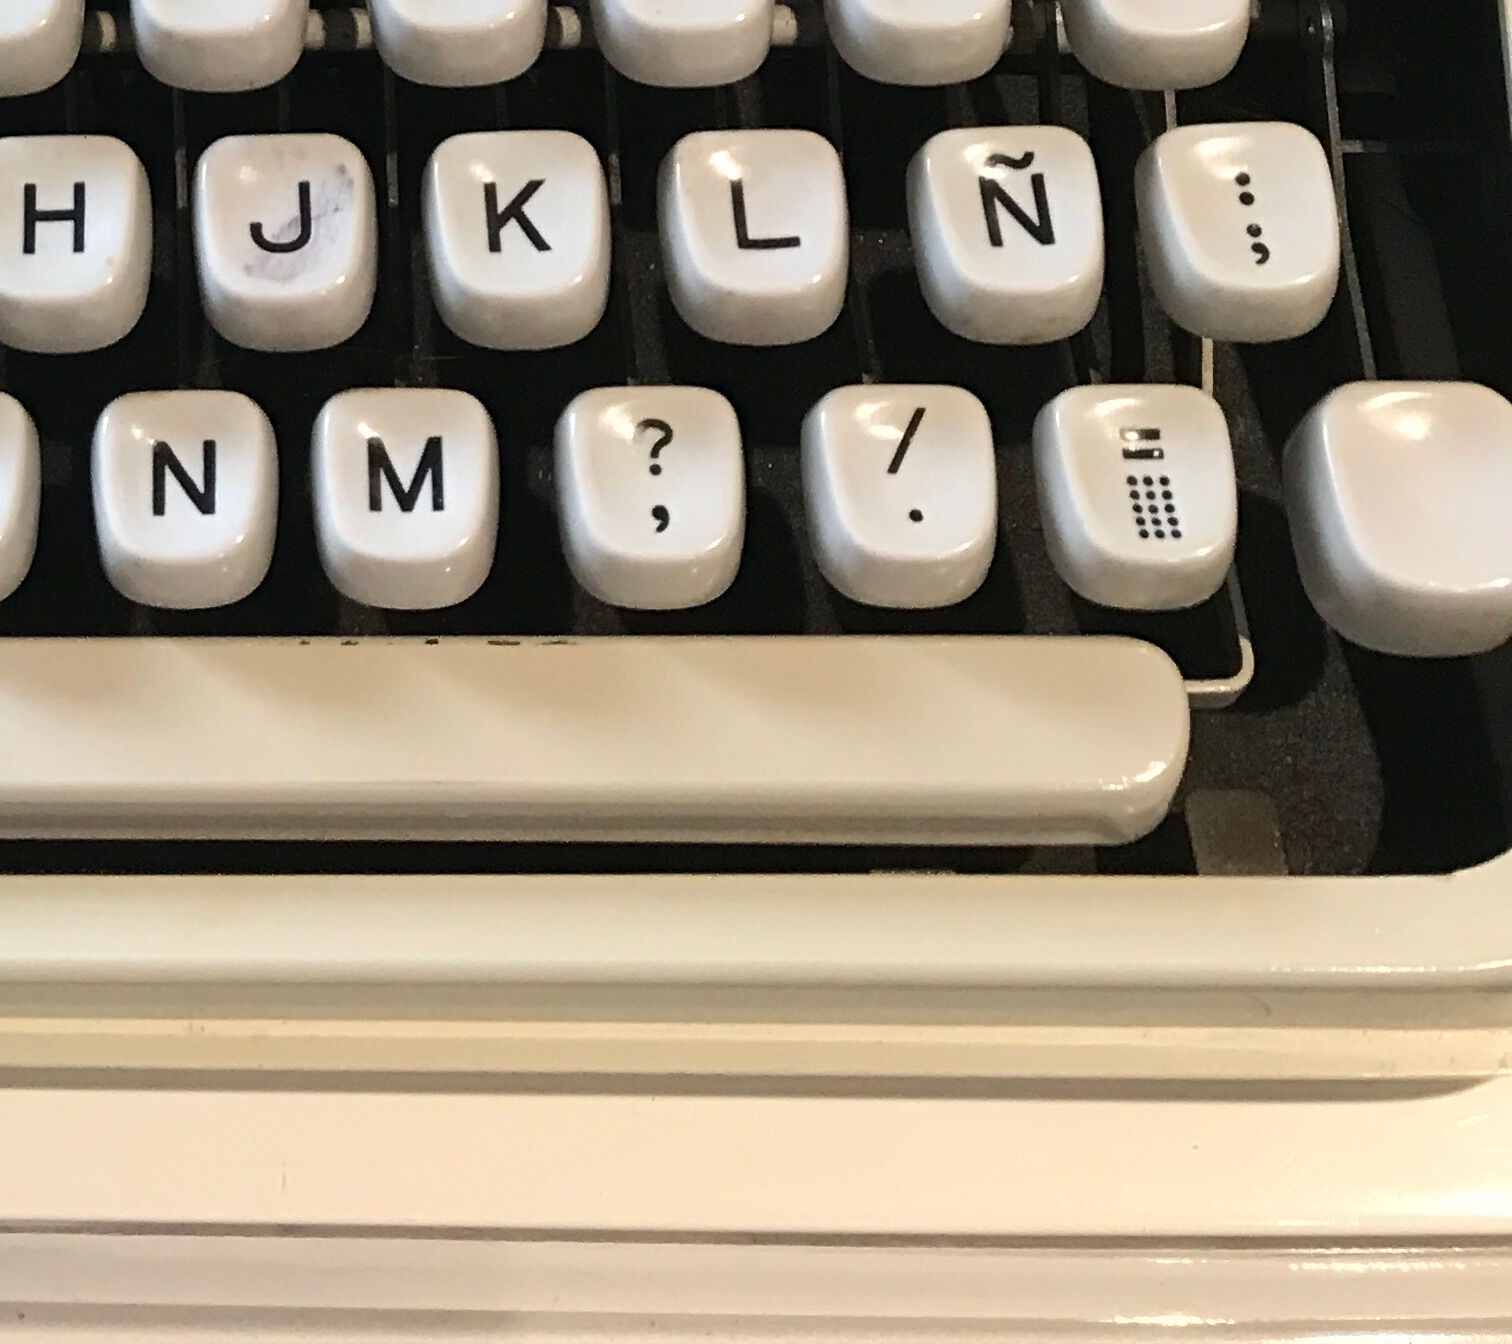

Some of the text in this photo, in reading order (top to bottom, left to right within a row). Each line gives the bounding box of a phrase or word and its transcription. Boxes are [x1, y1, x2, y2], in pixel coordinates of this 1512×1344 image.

[22, 181, 86, 255] H
[249, 180, 312, 254] J
[483, 179, 552, 253] K
[730, 180, 801, 250] L
[978, 151, 1056, 248] Ñ
[152, 439, 217, 516] N
[367, 435, 444, 513] M
[638, 418, 674, 476] ?
